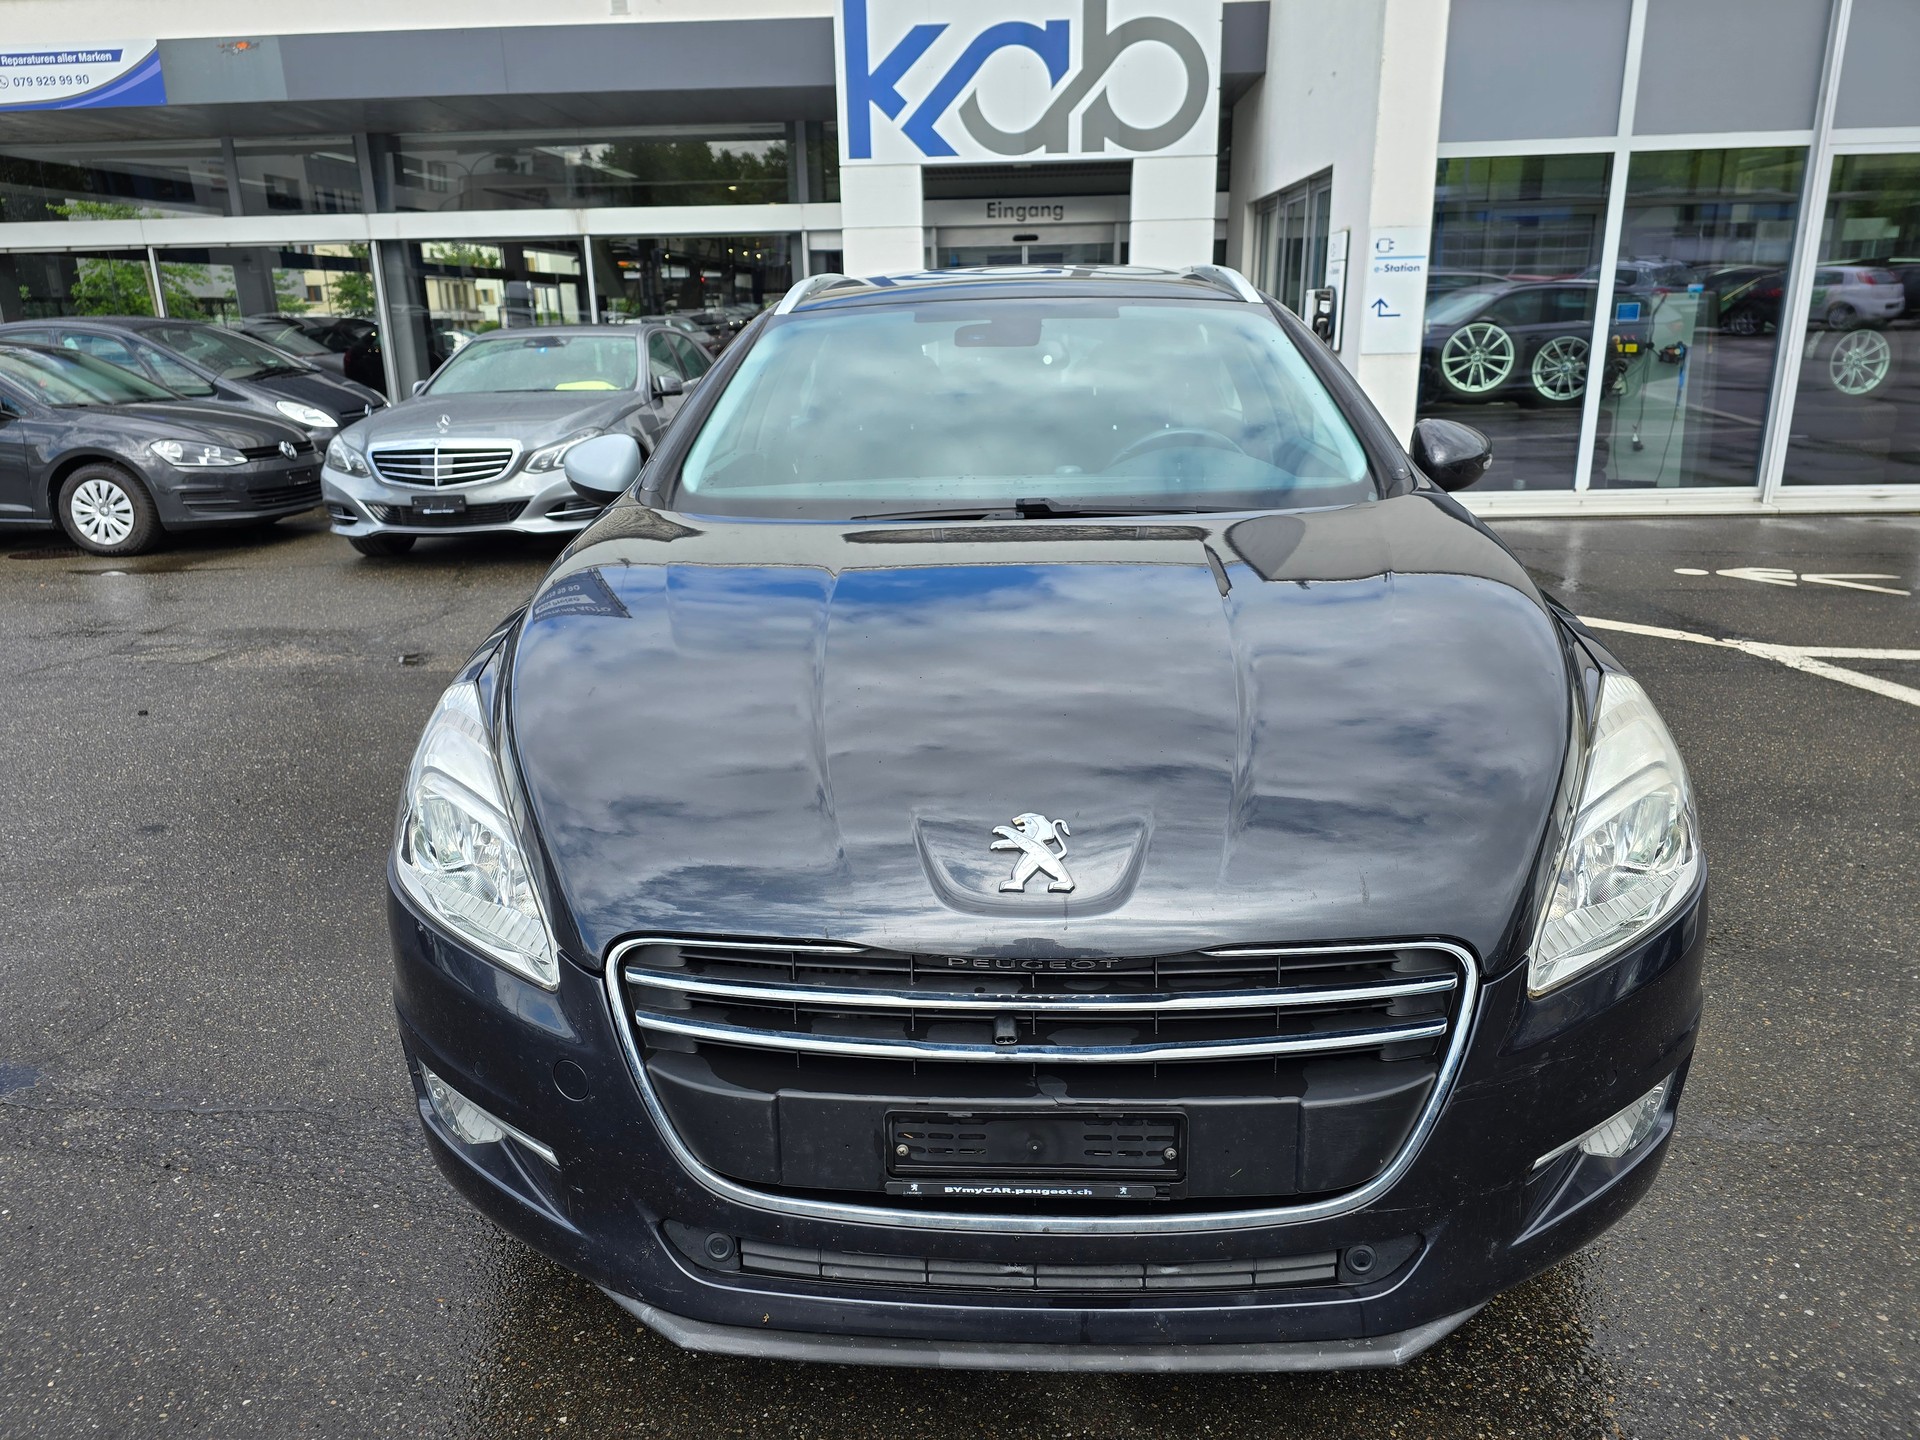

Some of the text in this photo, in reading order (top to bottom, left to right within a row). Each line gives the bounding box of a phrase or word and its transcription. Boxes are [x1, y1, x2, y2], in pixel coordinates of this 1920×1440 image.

[1, 52, 112, 67] Reparaturen aller Marken
[13, 74, 90, 87] 079 929 99 90
[843, 0, 1210, 159] kab
[986, 201, 1064, 222] Eingang
[1374, 262, 1421, 273] e-Station
[947, 957, 1120, 970] PEUGEOT
[944, 1186, 1093, 1196] BYmyCAR.peugeot.ch
